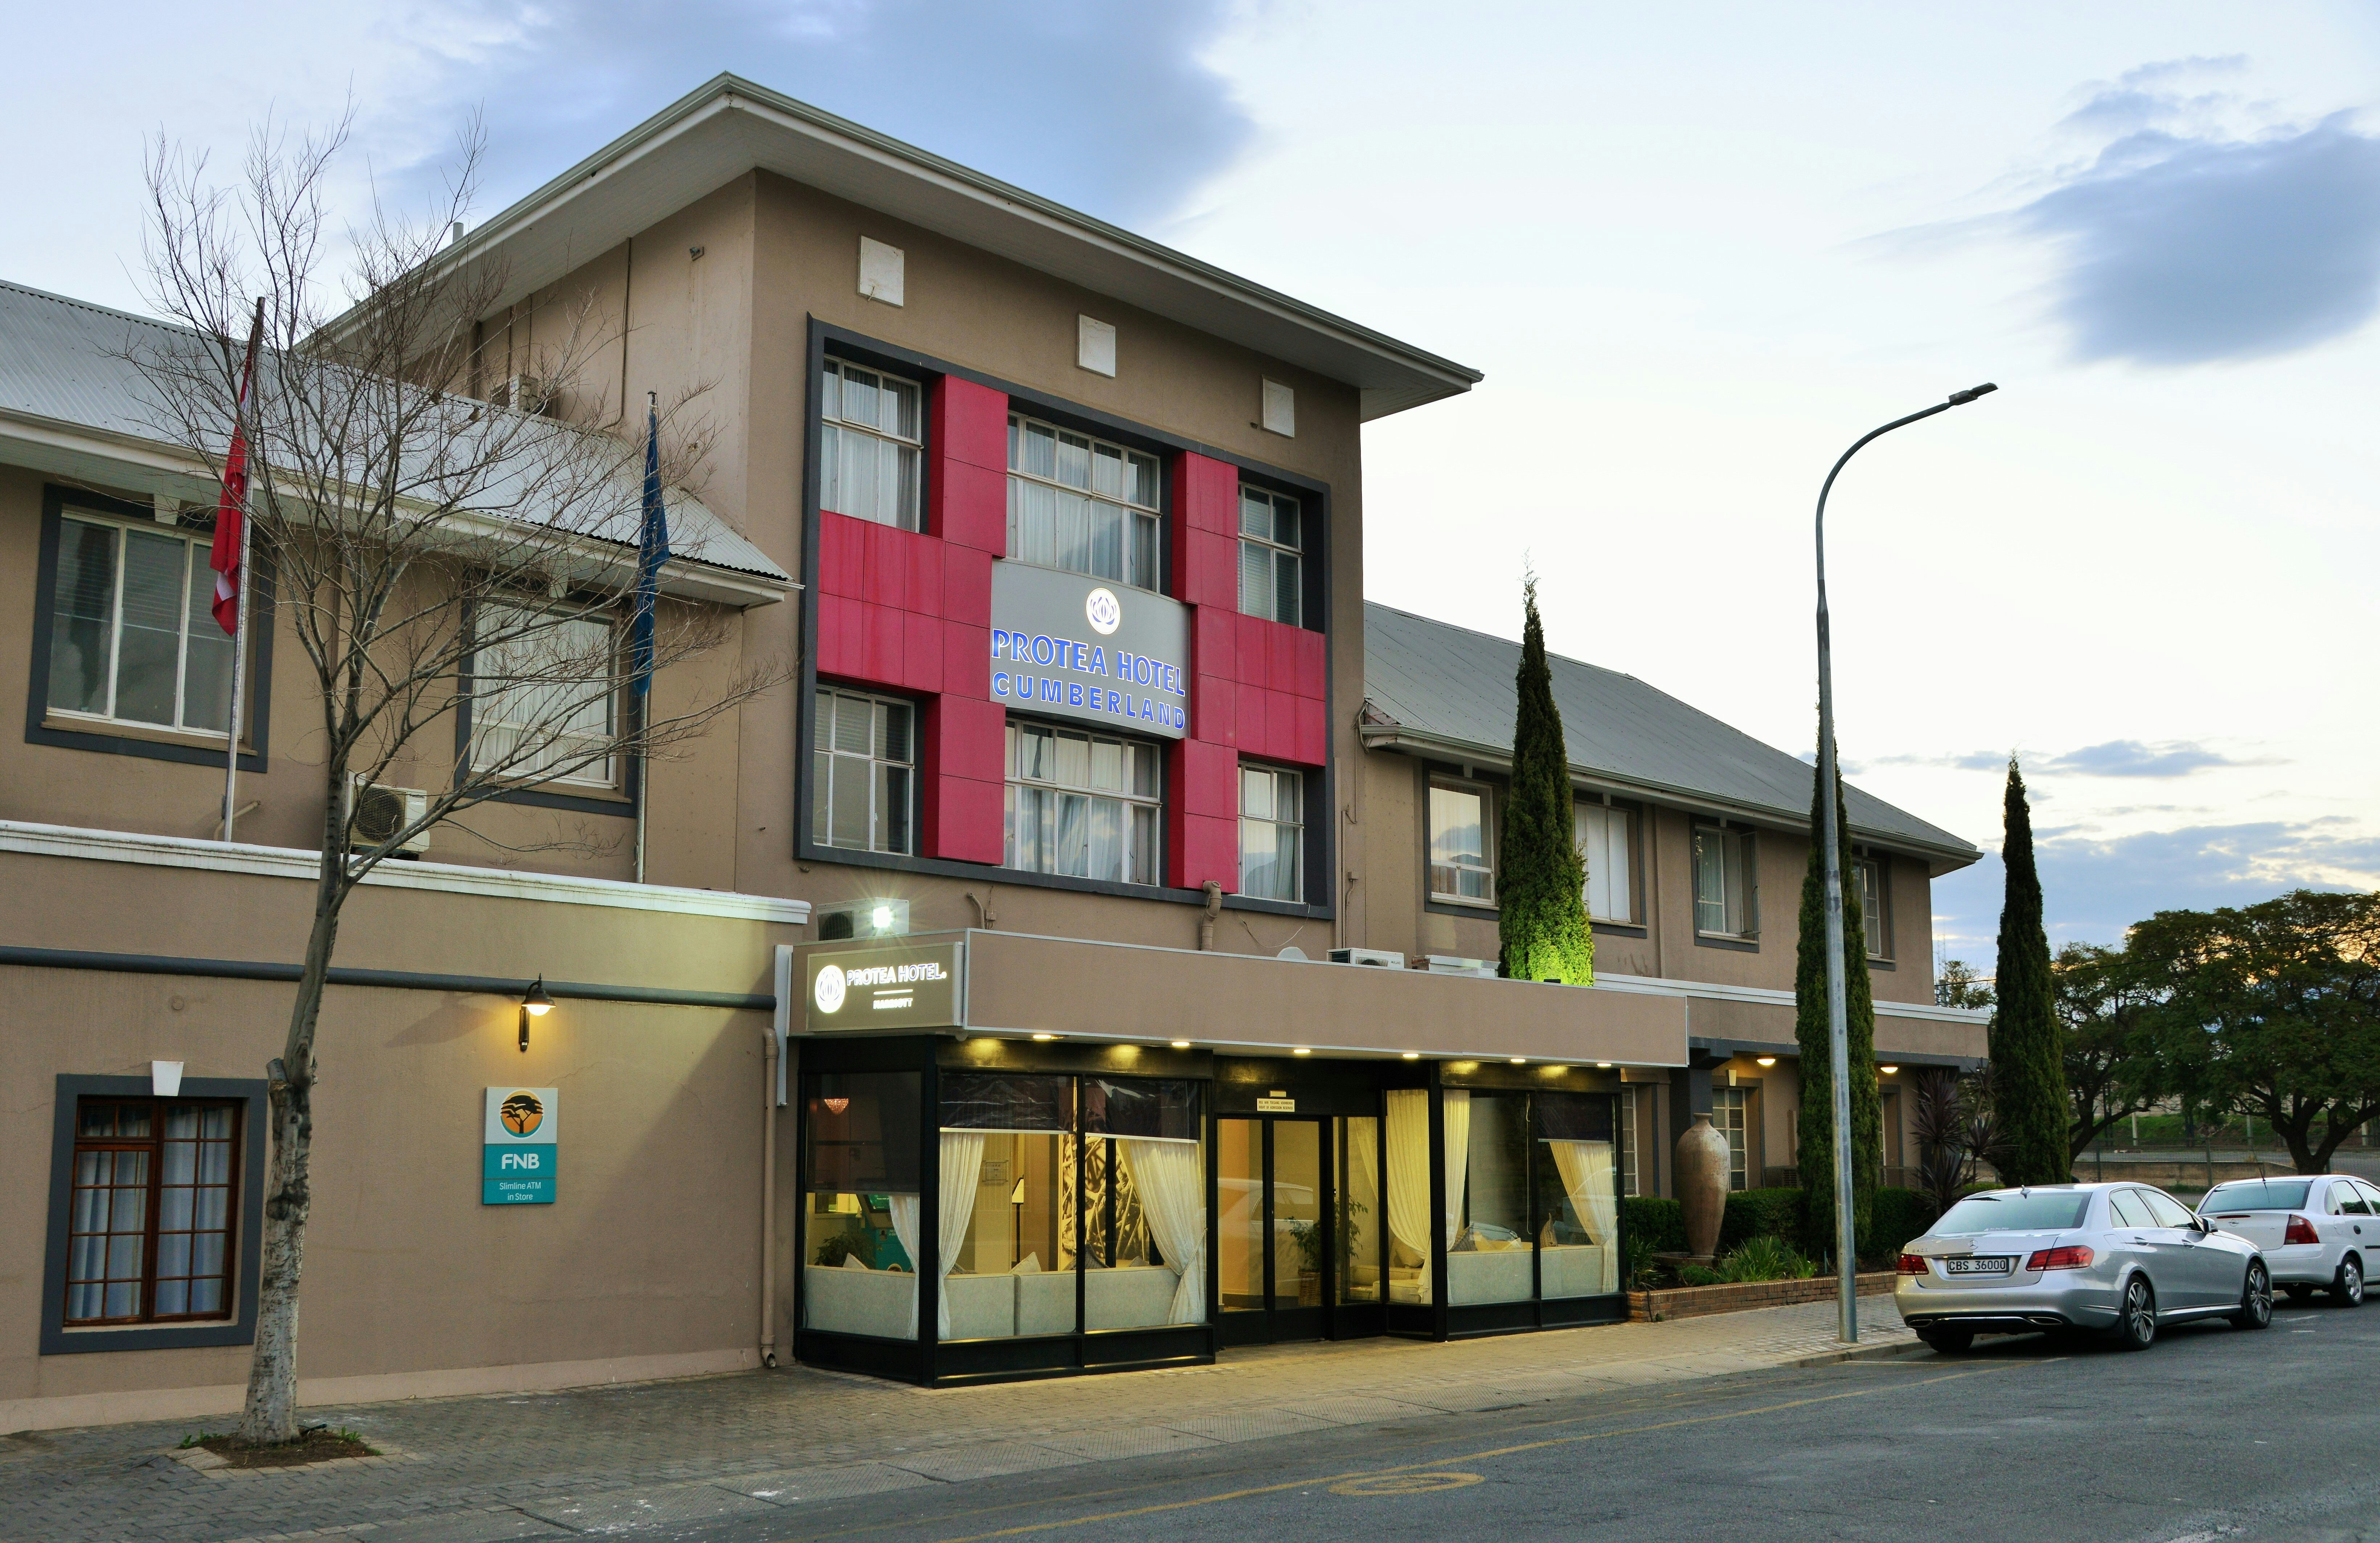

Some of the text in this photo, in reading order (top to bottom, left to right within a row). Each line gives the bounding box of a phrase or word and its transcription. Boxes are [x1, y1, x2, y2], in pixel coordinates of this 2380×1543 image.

[992, 628, 1185, 697] PROTEA HOTEL
[992, 671, 1185, 730] CUMBERLAND
[847, 966, 896, 986] PROTEA
[501, 1153, 540, 1169] FNB
[1949, 1260, 2006, 1271] CBS 36000
